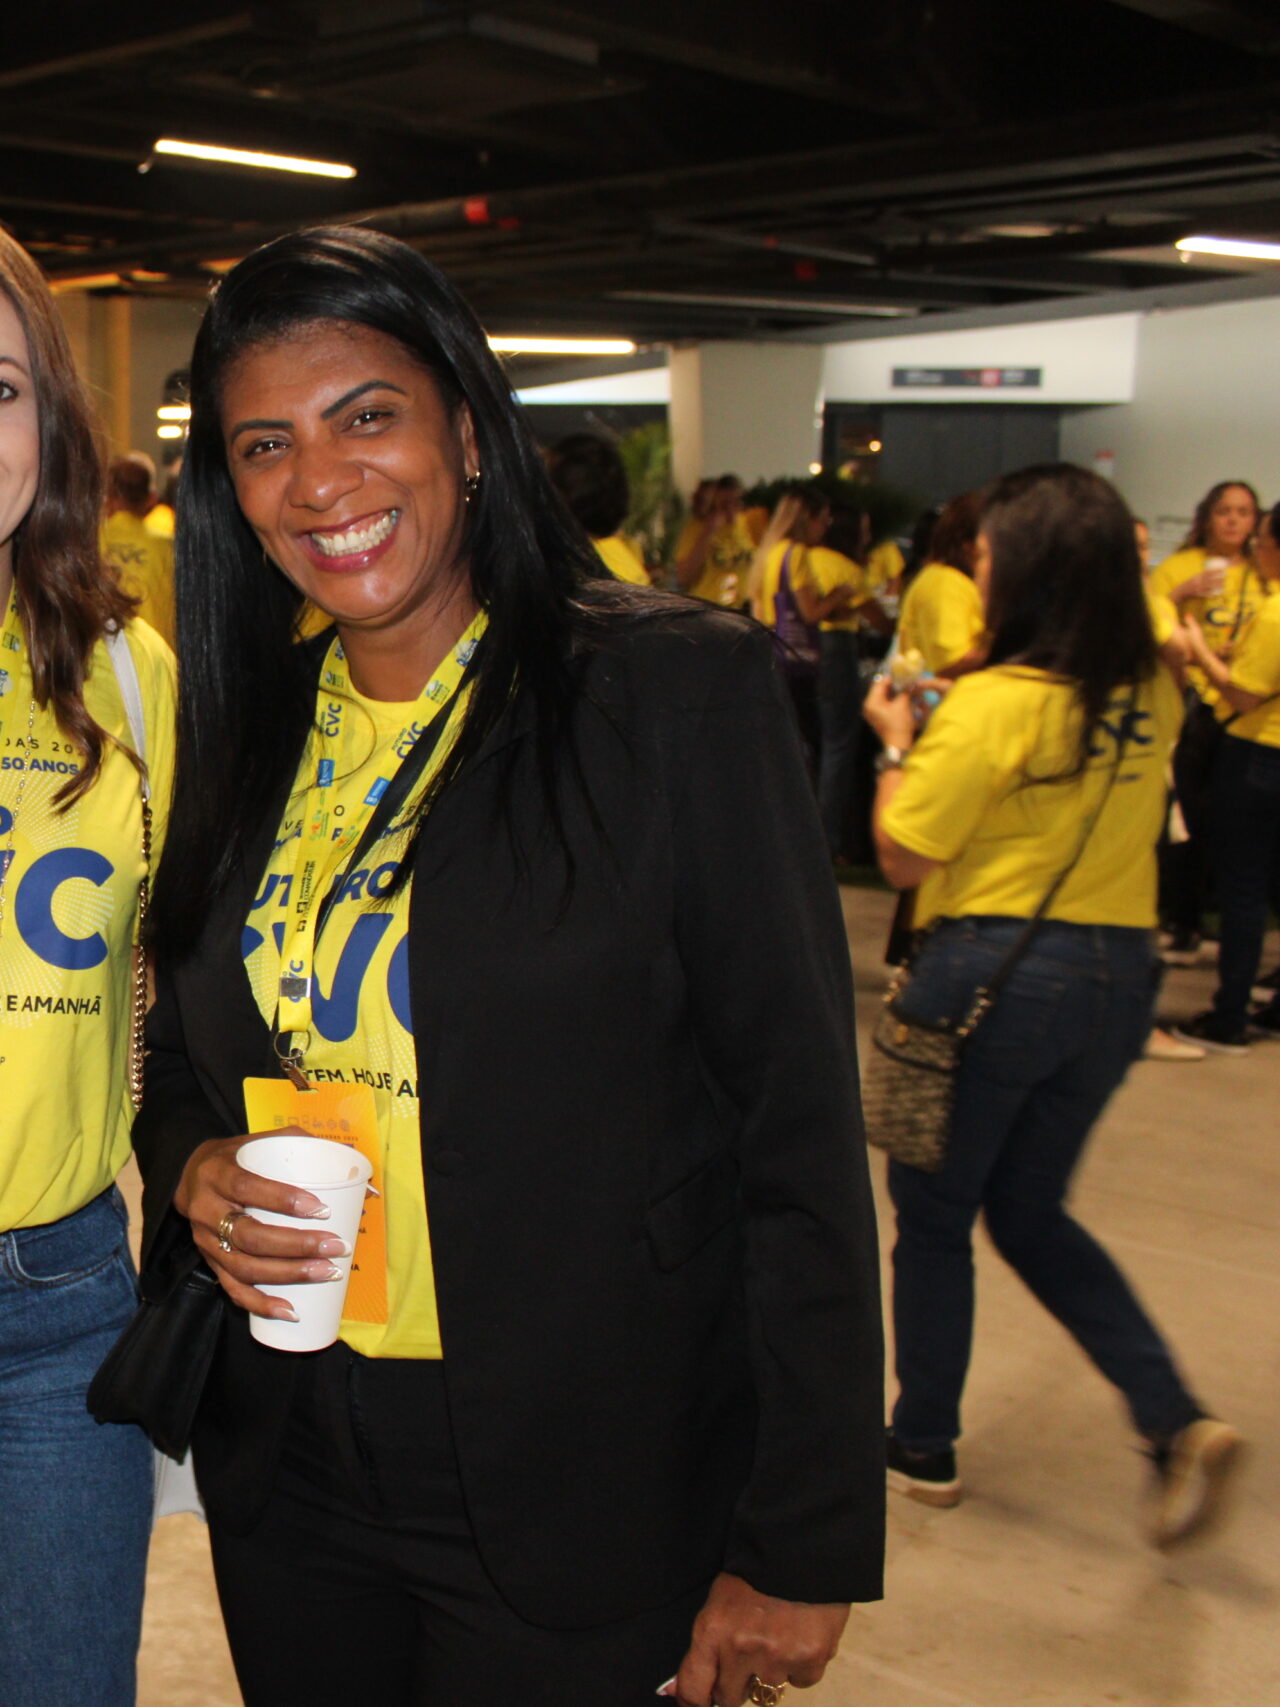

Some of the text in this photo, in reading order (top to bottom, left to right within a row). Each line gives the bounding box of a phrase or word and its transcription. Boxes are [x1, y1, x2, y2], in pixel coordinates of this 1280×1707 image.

[325, 703, 342, 738] CVC
[1, 757, 26, 770] 50
[28, 757, 81, 776] ANOS
[6, 995, 18, 1012] E
[21, 994, 102, 1016] AMANHÃ
[352, 1067, 392, 1091] HOJE
